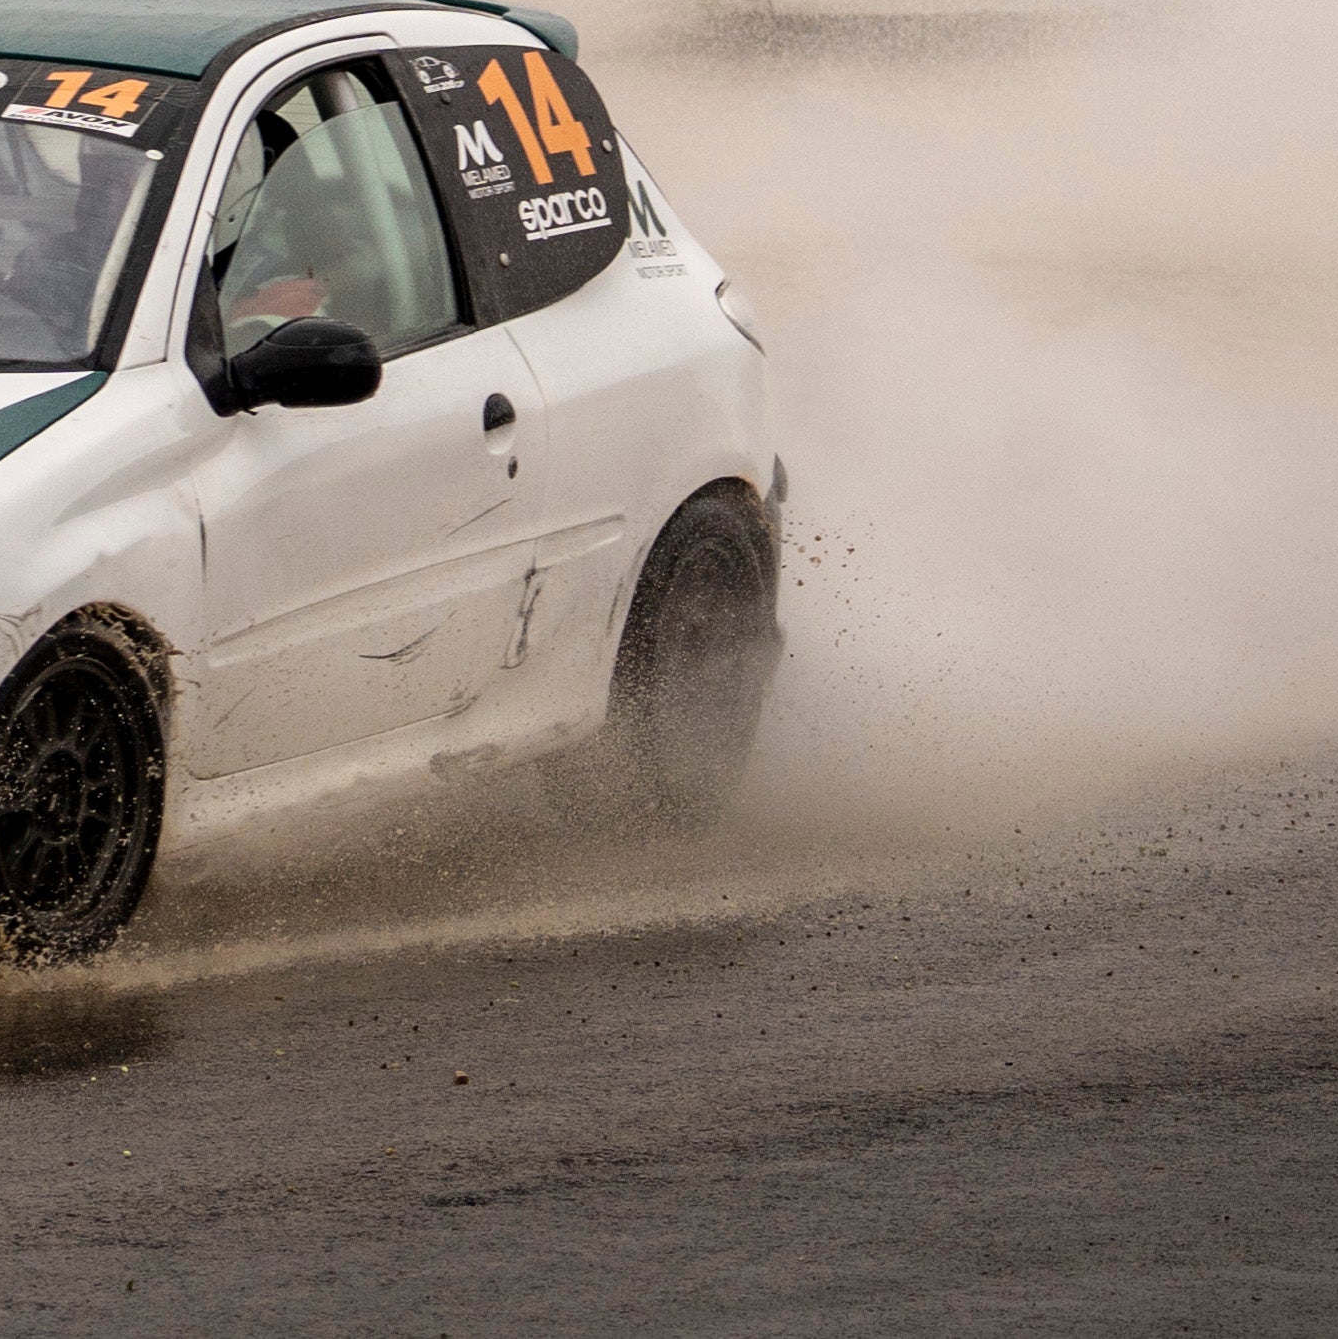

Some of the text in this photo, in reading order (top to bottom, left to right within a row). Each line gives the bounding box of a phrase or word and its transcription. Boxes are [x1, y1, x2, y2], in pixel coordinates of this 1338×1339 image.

[42, 109, 132, 129] AVON
[44, 70, 150, 119] 14
[477, 50, 597, 186] 14
[453, 119, 504, 171] M
[518, 186, 613, 241] sparco
